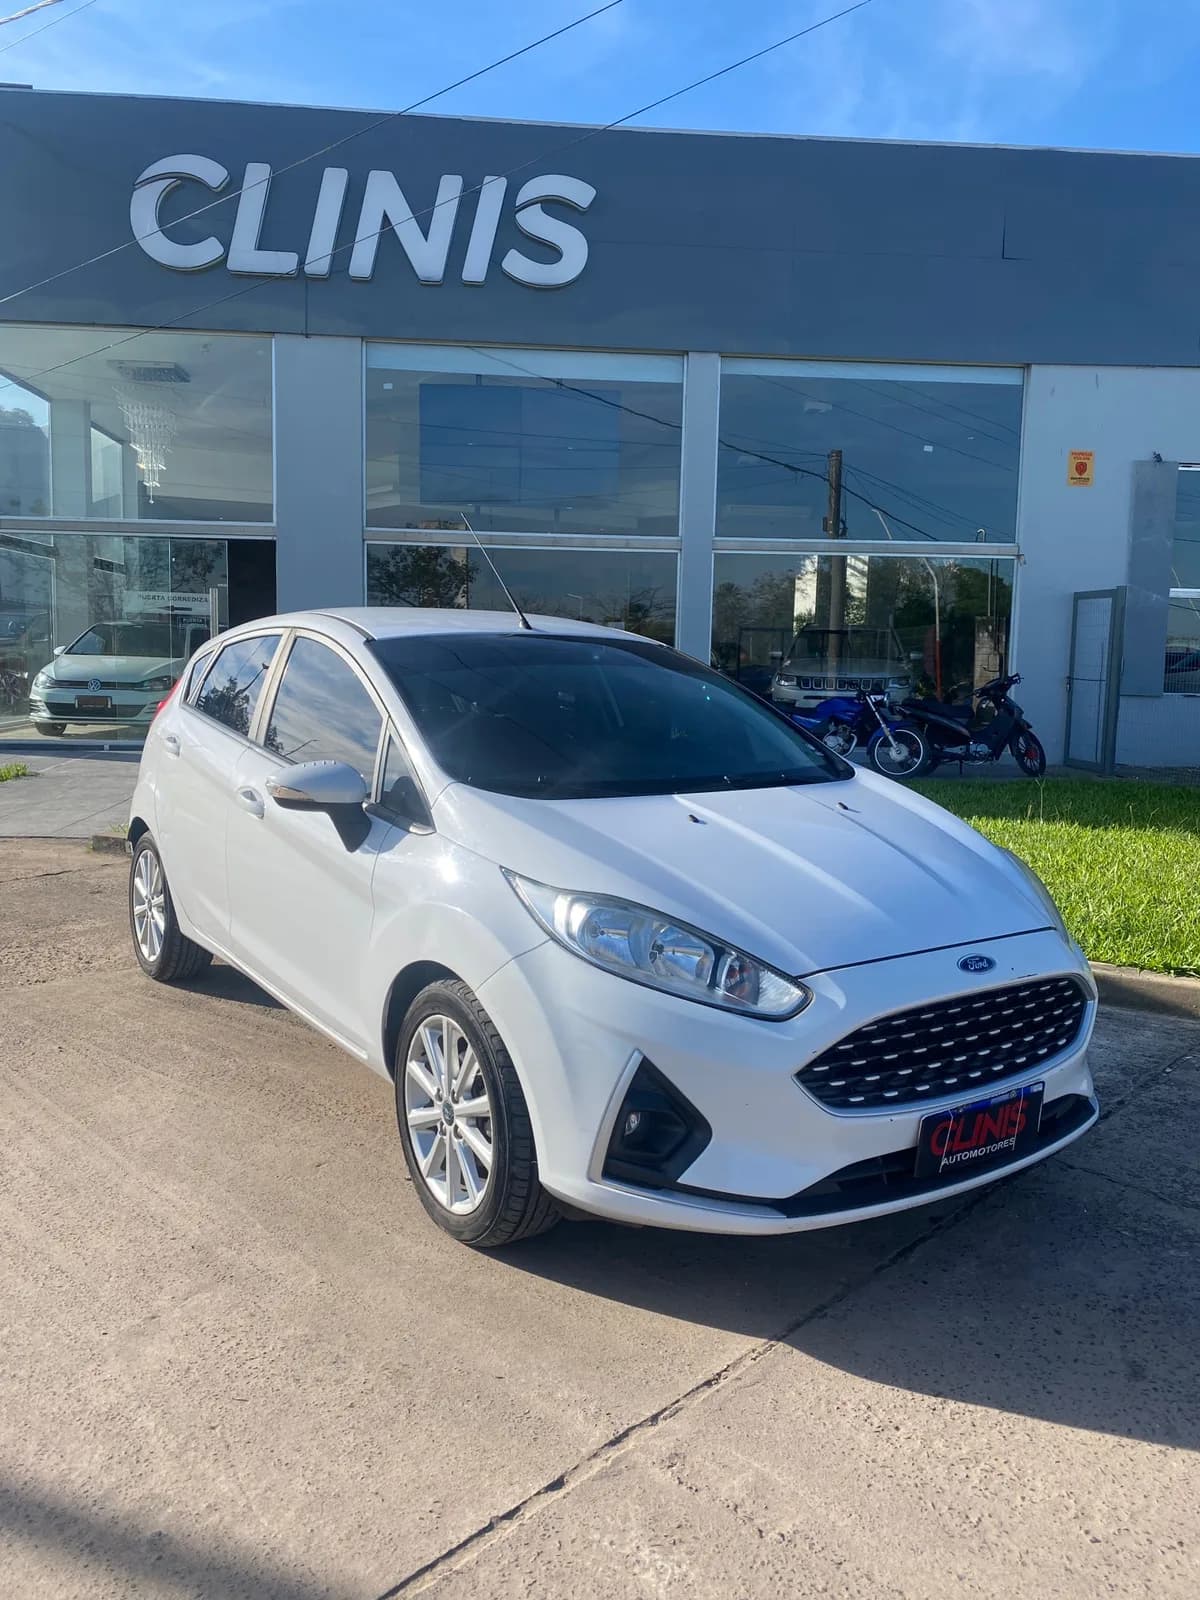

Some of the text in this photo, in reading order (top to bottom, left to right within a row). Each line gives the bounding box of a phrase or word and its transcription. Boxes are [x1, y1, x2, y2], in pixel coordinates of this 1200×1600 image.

[129, 153, 597, 289] CLINIS
[930, 1101, 1028, 1157] CLINIS
[940, 1136, 1016, 1167] AUTOMOTORES
